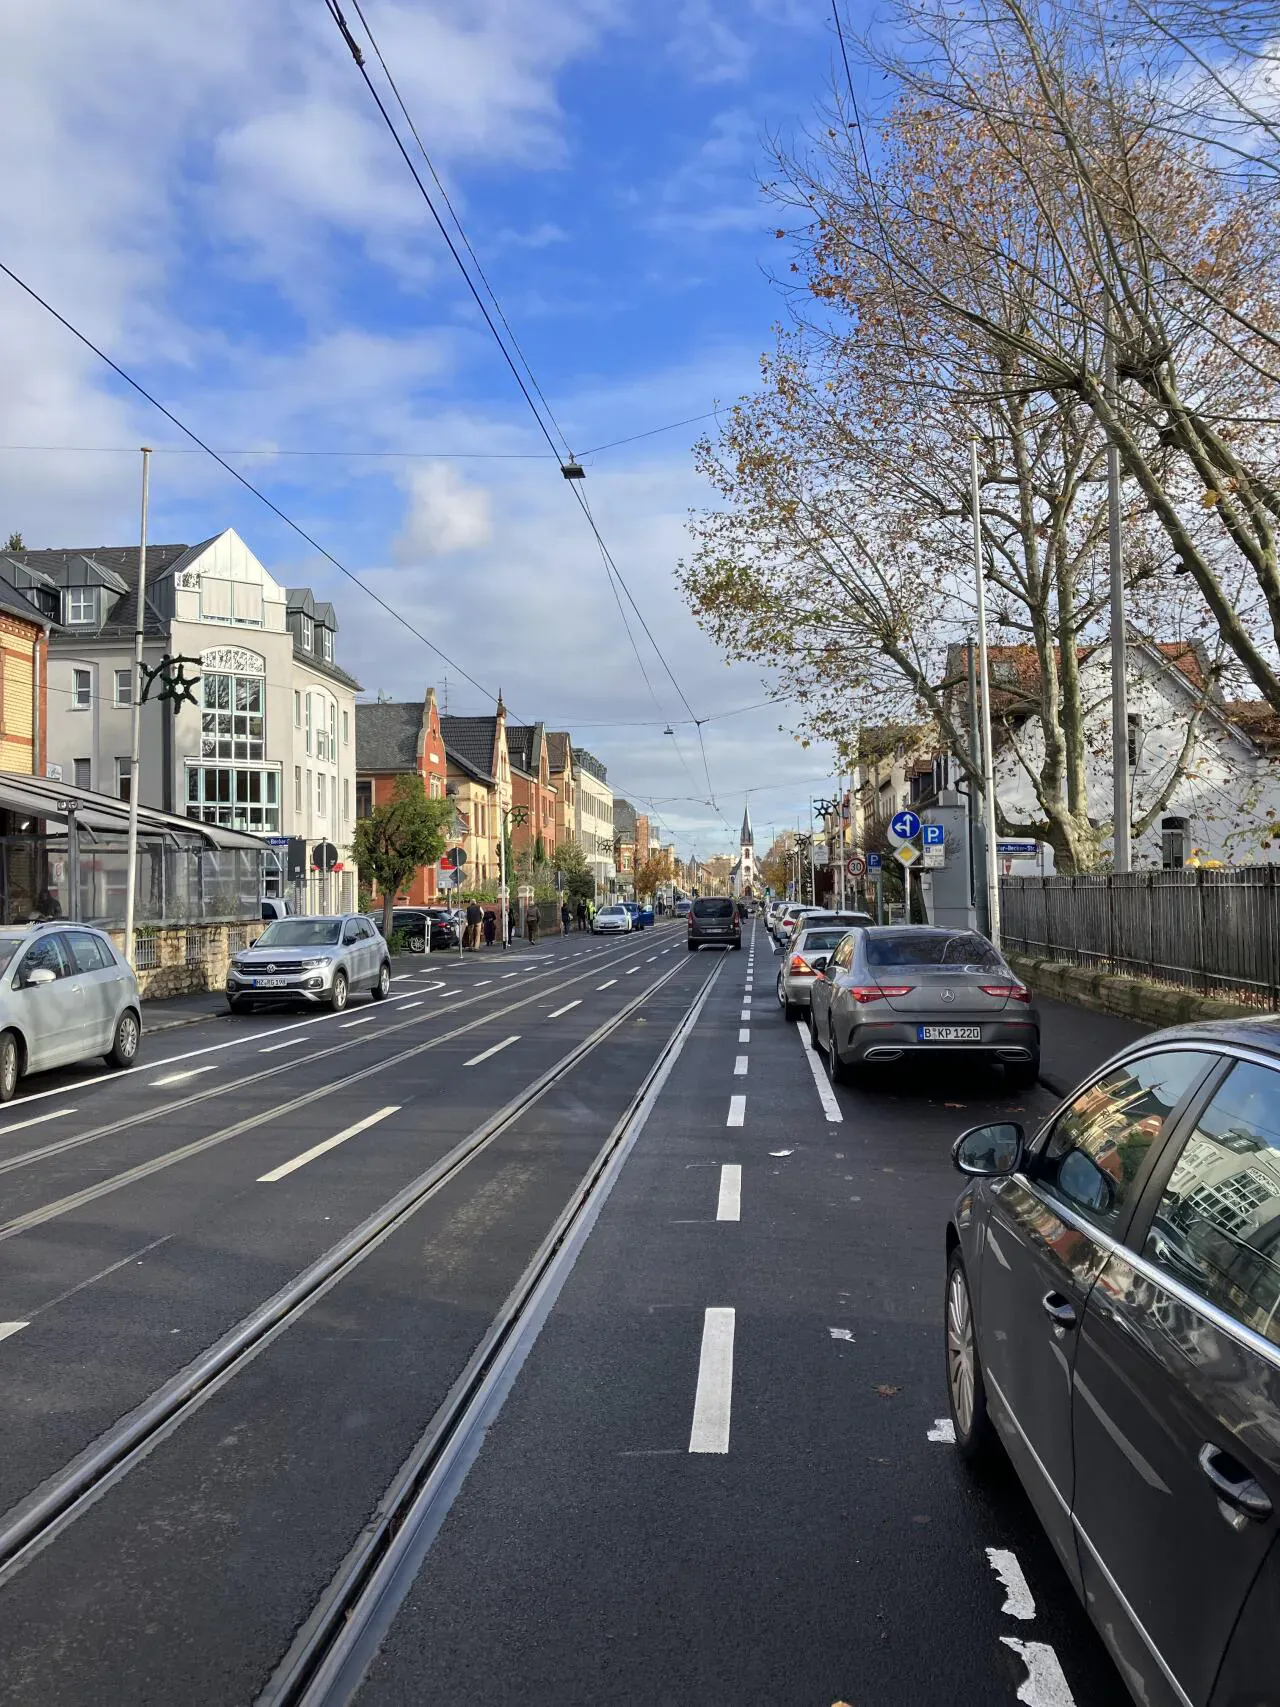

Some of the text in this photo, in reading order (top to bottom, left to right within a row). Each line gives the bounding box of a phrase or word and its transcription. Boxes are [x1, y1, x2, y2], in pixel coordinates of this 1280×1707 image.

[928, 827, 939, 843] P
[870, 855, 879, 866] P
[850, 862, 862, 871] 30
[924, 1028, 979, 1038] B KP 1220
